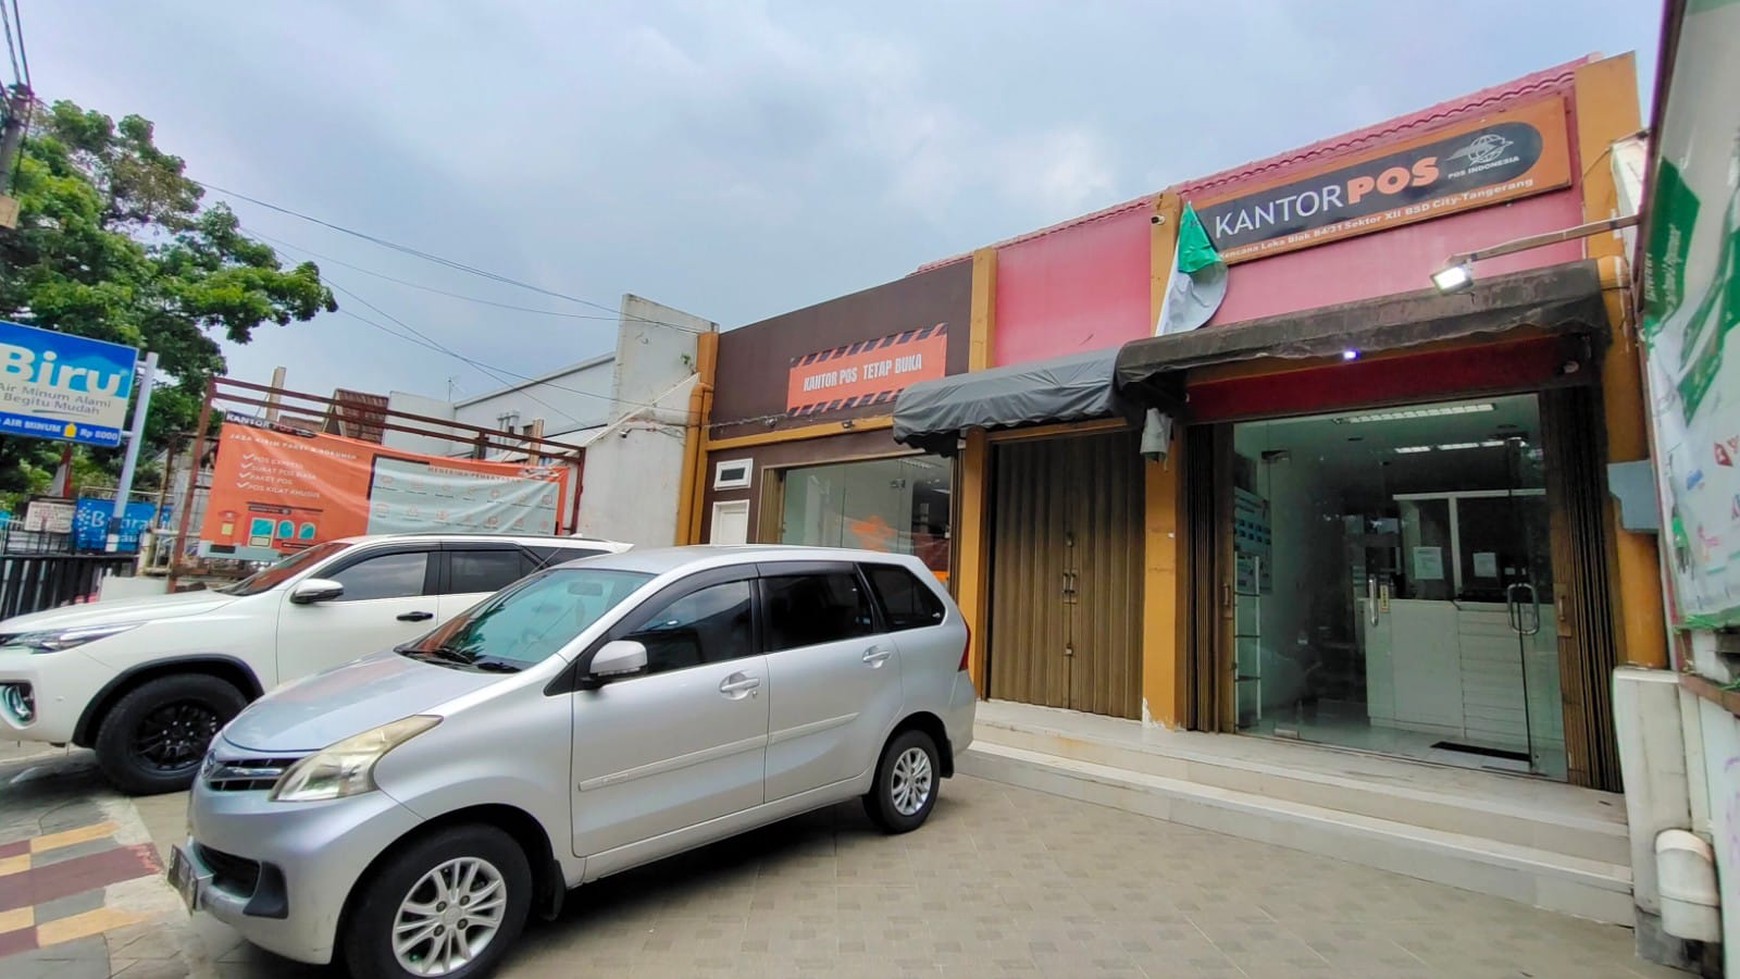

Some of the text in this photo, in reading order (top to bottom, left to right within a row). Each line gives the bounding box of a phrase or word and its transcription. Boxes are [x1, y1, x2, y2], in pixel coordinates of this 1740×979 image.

[1448, 156, 1520, 180] POS INDONESIA
[1215, 157, 1439, 239] KANTOR POS
[1345, 216, 1382, 230] Sektor
[1405, 202, 1430, 216] BSD
[0, 343, 120, 397] Biru
[803, 353, 922, 392] KANTOR POS TETAP BUKA
[0, 383, 111, 408] Air Minum Alami
[4, 392, 100, 415] Begitu Mudah
[3, 418, 22, 428] AIR
